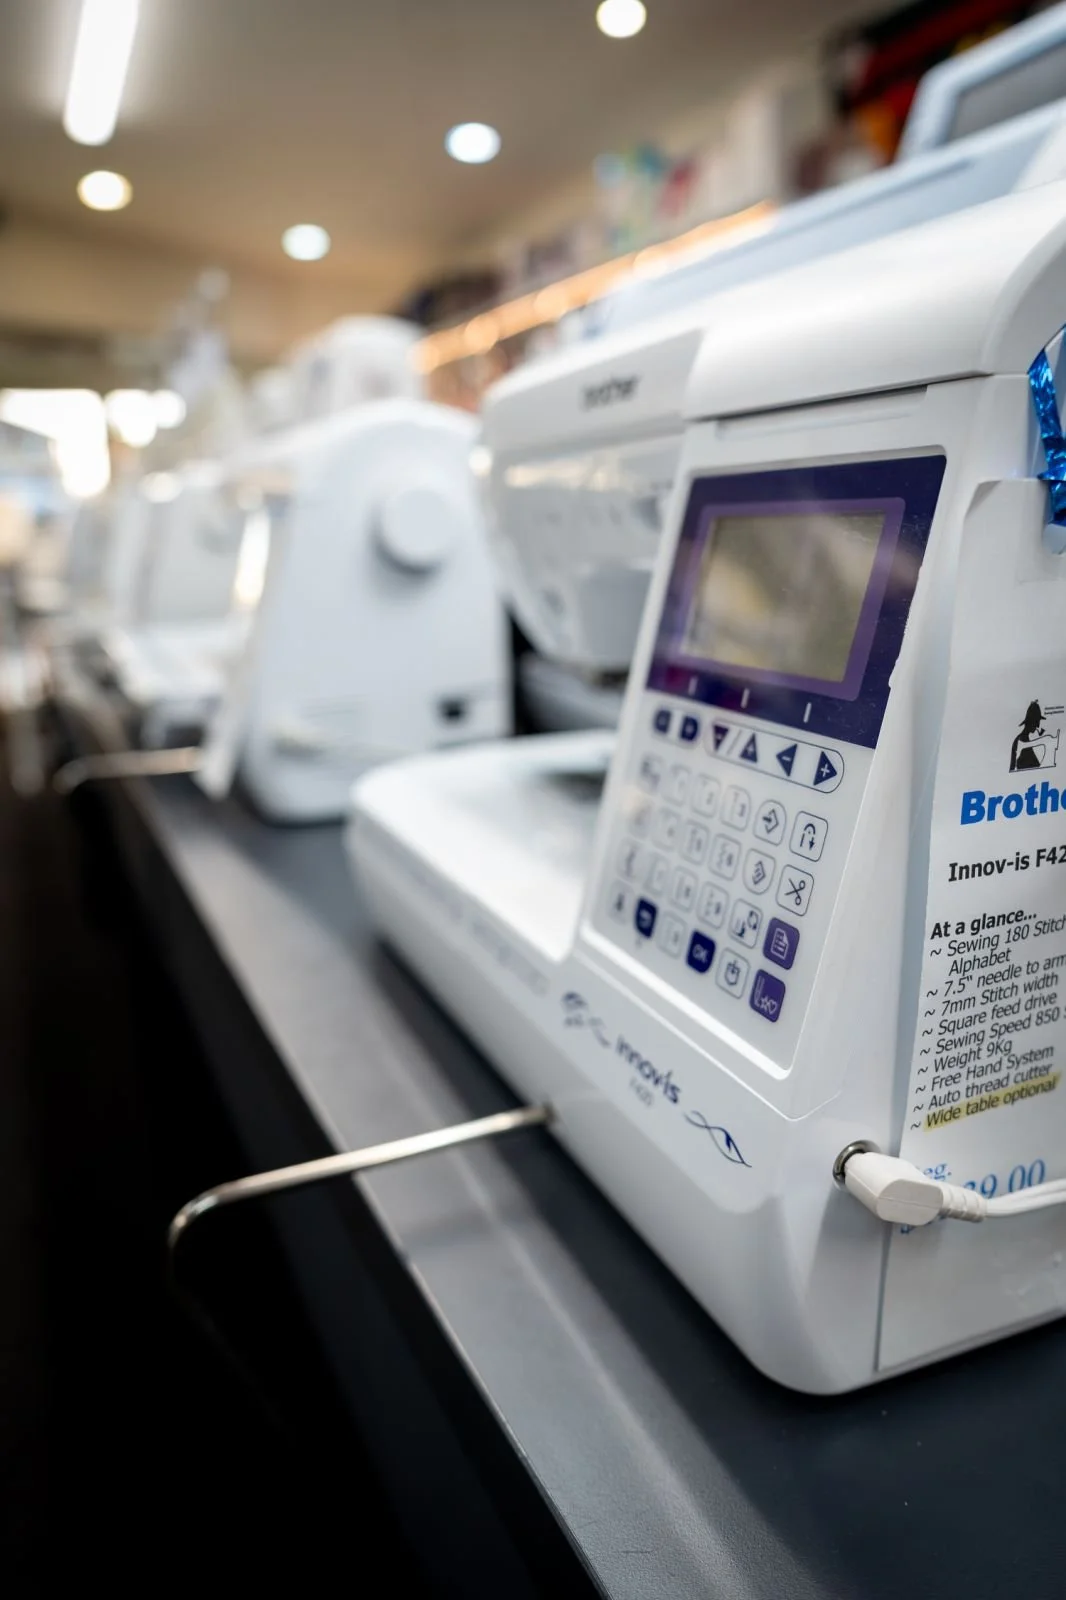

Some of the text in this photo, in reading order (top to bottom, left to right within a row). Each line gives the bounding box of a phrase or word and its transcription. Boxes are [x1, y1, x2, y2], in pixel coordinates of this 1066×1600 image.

[960, 781, 1066, 825] Broth
[948, 851, 1030, 882] Innov-is
[930, 910, 1037, 940] At a glance...
[947, 934, 1000, 957] Sewing
[1005, 924, 1030, 944] 180
[948, 948, 1012, 976] Alphabet
[977, 964, 1022, 988] needle
[1026, 960, 1039, 975] to
[941, 996, 976, 1016] 7mm
[980, 982, 1019, 1005] Stitch
[1023, 972, 1058, 994] width
[935, 1030, 986, 1054] Sewing
[989, 1013, 1032, 1040] Speed
[1035, 1006, 1060, 1026] 850
[938, 1011, 987, 1036] Square
[991, 998, 1021, 1020] feed
[1024, 992, 1058, 1012] drive
[931, 1072, 961, 1092] Free
[966, 1058, 1002, 1080] Hand
[1006, 1046, 1054, 1070] System
[934, 1047, 982, 1072] Weight
[986, 1039, 1013, 1058] 9Kg
[926, 1106, 961, 1128] Wide
[966, 1094, 999, 1116] table
[1003, 1076, 1057, 1106] optional
[928, 1090, 960, 1110] Auto
[965, 1073, 1010, 1098] thread
[1013, 1063, 1052, 1084] cutter
[917, 1163, 951, 1180] eg.
